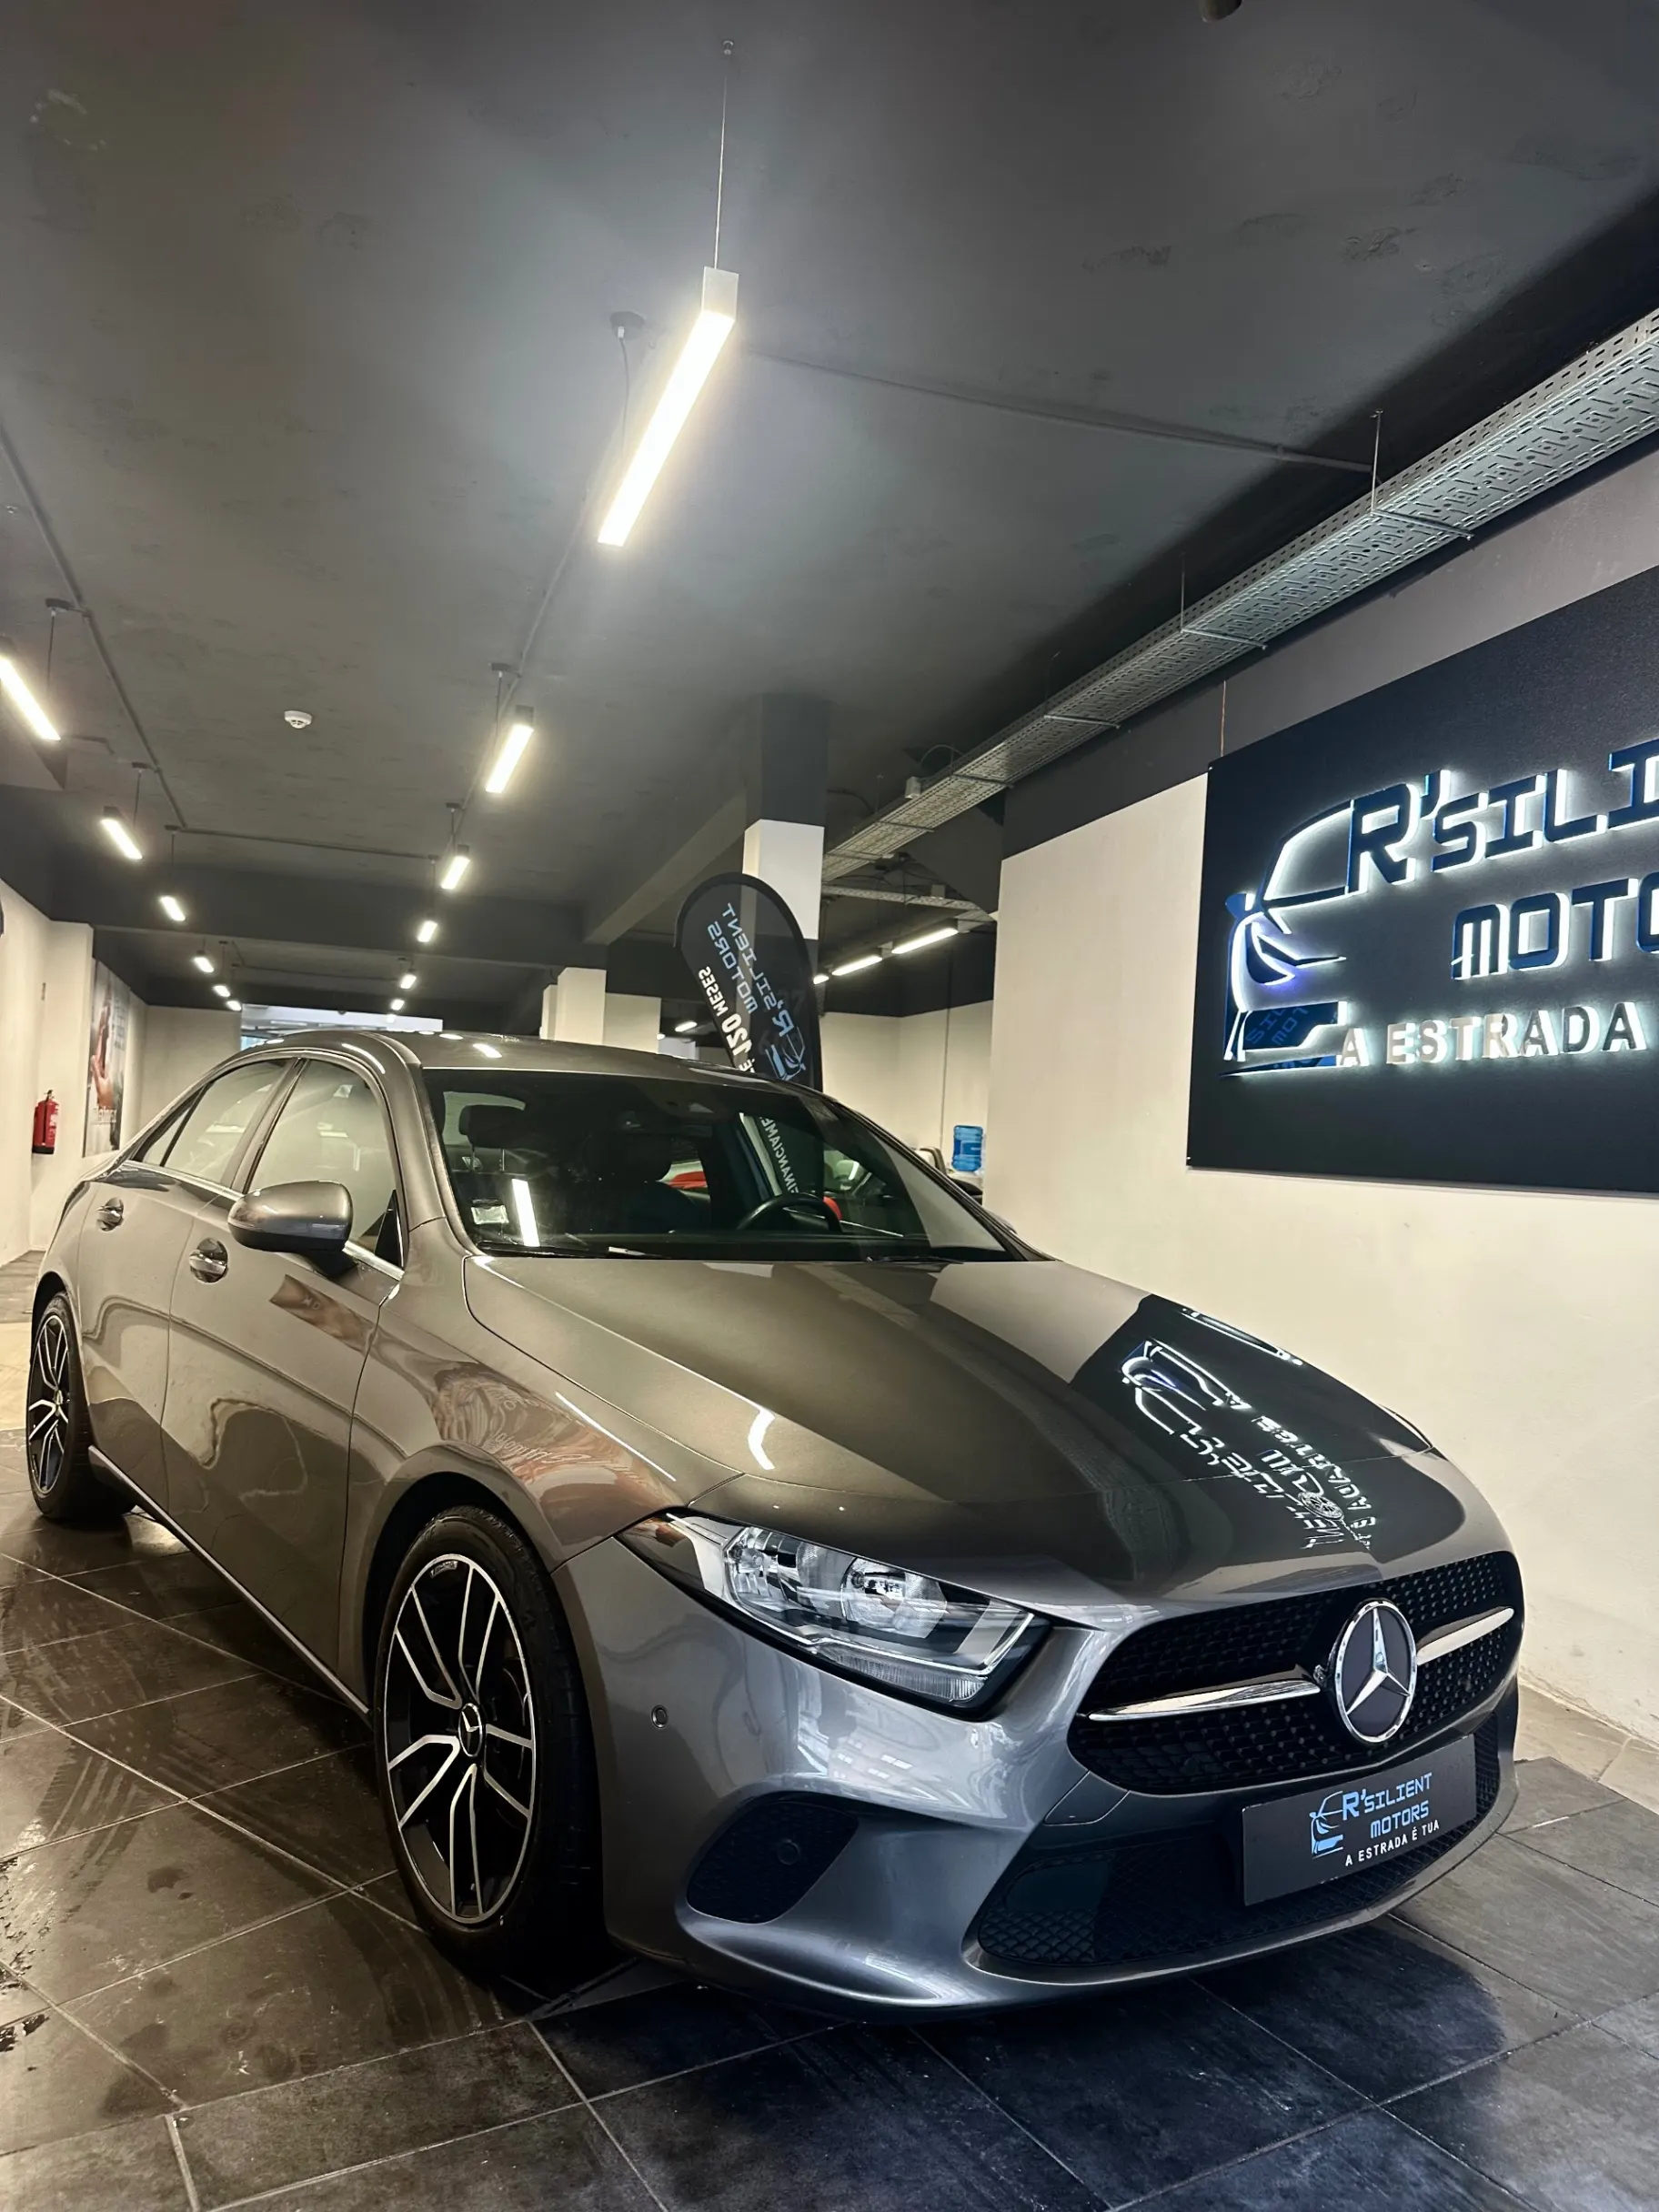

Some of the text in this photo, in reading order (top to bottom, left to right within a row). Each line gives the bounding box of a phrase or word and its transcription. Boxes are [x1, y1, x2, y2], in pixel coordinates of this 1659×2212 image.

[1340, 1001, 1648, 1067] A ESTRADA
[1342, 1772, 1433, 1821] R'SILIENT
[1371, 1800, 1429, 1839] MOTORS
[1344, 1819, 1440, 1866] A ESTRADA É TUA
